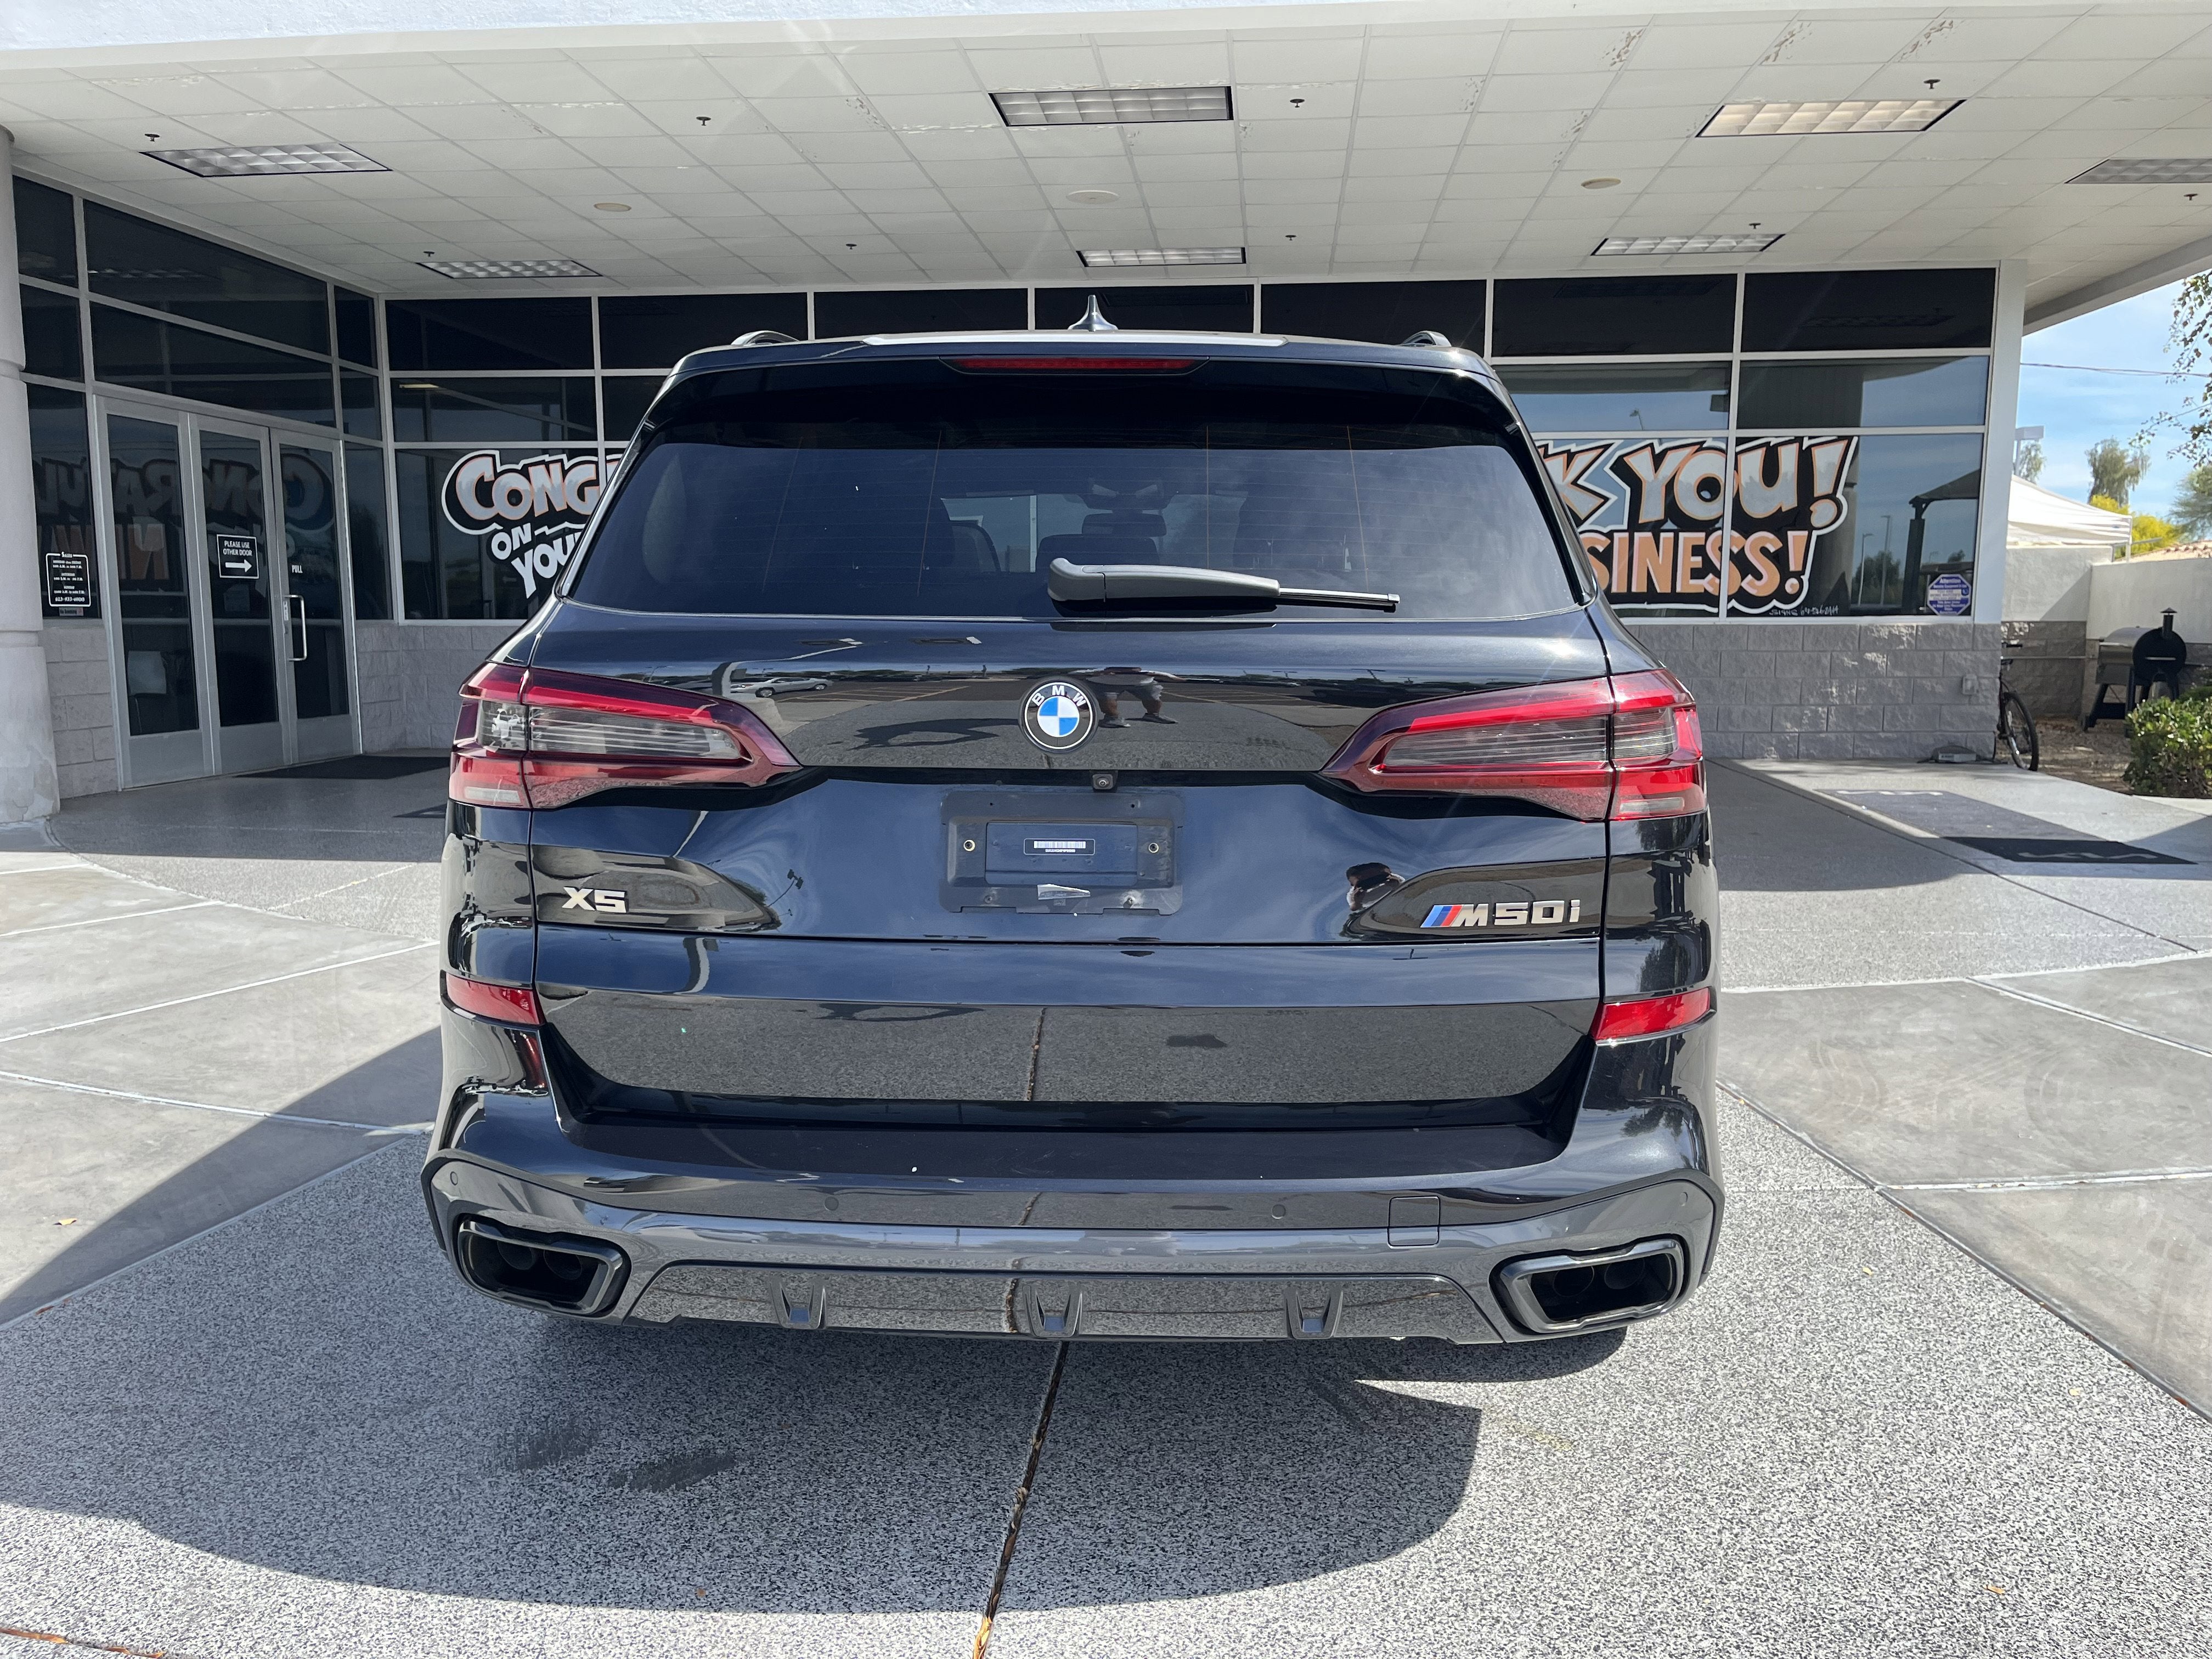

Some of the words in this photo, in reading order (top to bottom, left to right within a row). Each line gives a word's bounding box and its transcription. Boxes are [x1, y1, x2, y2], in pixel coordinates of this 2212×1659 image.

[1623, 439, 1848, 527] YOU!
[491, 522, 532, 560] ON
[292, 565, 303, 573] PULL
[511, 531, 580, 599] YOU
[1579, 530, 1808, 597] SINESS!
[1031, 685, 1086, 707] BMW
[561, 887, 627, 913] X5
[1448, 899, 1581, 927] M50i
